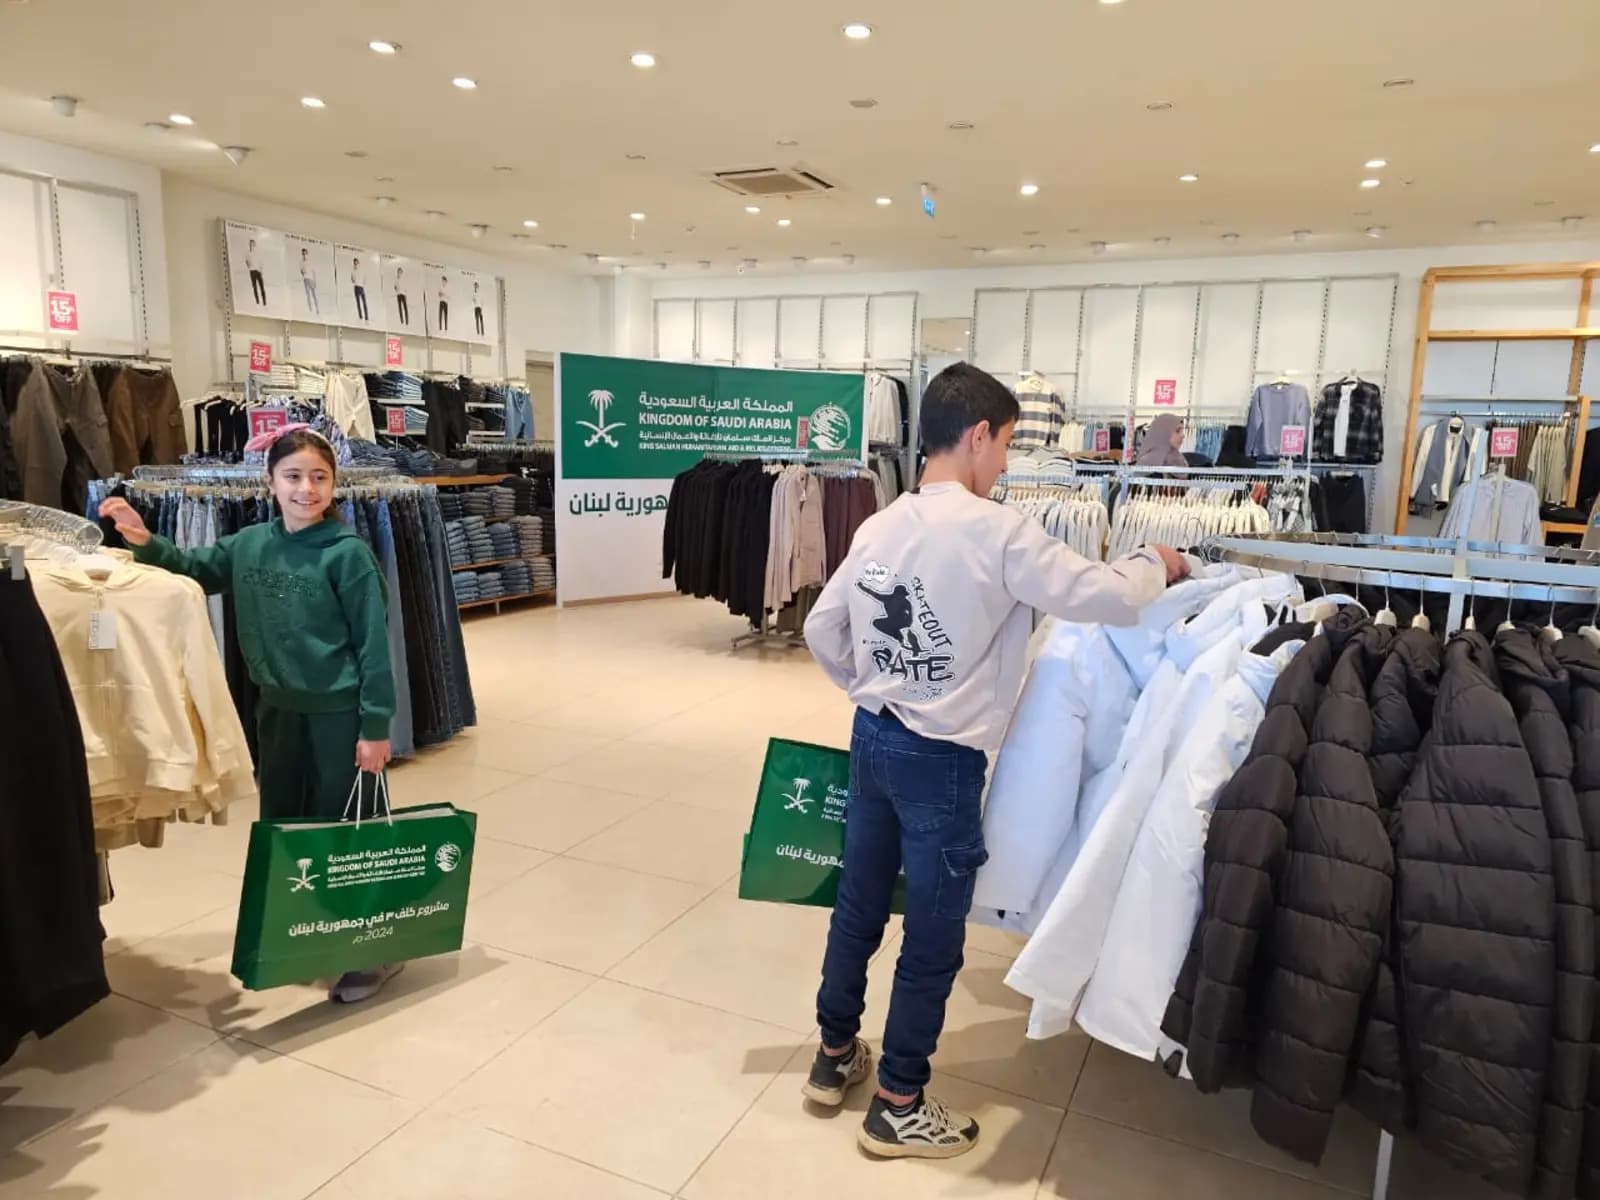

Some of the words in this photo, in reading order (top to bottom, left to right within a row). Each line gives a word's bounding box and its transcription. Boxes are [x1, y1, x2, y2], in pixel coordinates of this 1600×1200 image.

[54, 314, 73, 323] OFF
[639, 391, 697, 409] السعودية
[699, 395, 740, 412] العربية
[743, 397, 793, 412] المملكة
[639, 412, 693, 426] KINGDOM
[694, 414, 709, 426] OF
[710, 415, 746, 428] SAUDI
[748, 417, 792, 430] ARABIA
[569, 492, 610, 517] لبنان
[615, 491, 670, 516] هورية
[825, 796, 846, 807] KING
[365, 849, 393, 860] العربية
[394, 844, 426, 855] المملكة
[776, 844, 802, 860] لبنان
[327, 852, 364, 865] السعودية
[327, 863, 361, 874] KINGDOM
[362, 861, 373, 869] OF
[374, 858, 397, 868] SAUDI
[398, 855, 425, 865] ARABIA
[803, 848, 844, 868] هورية
[416, 901, 449, 917] مشروع
[315, 917, 364, 934] جمهورية
[365, 911, 385, 928] في
[288, 922, 315, 937] لبنان
[363, 926, 394, 942] 2024
